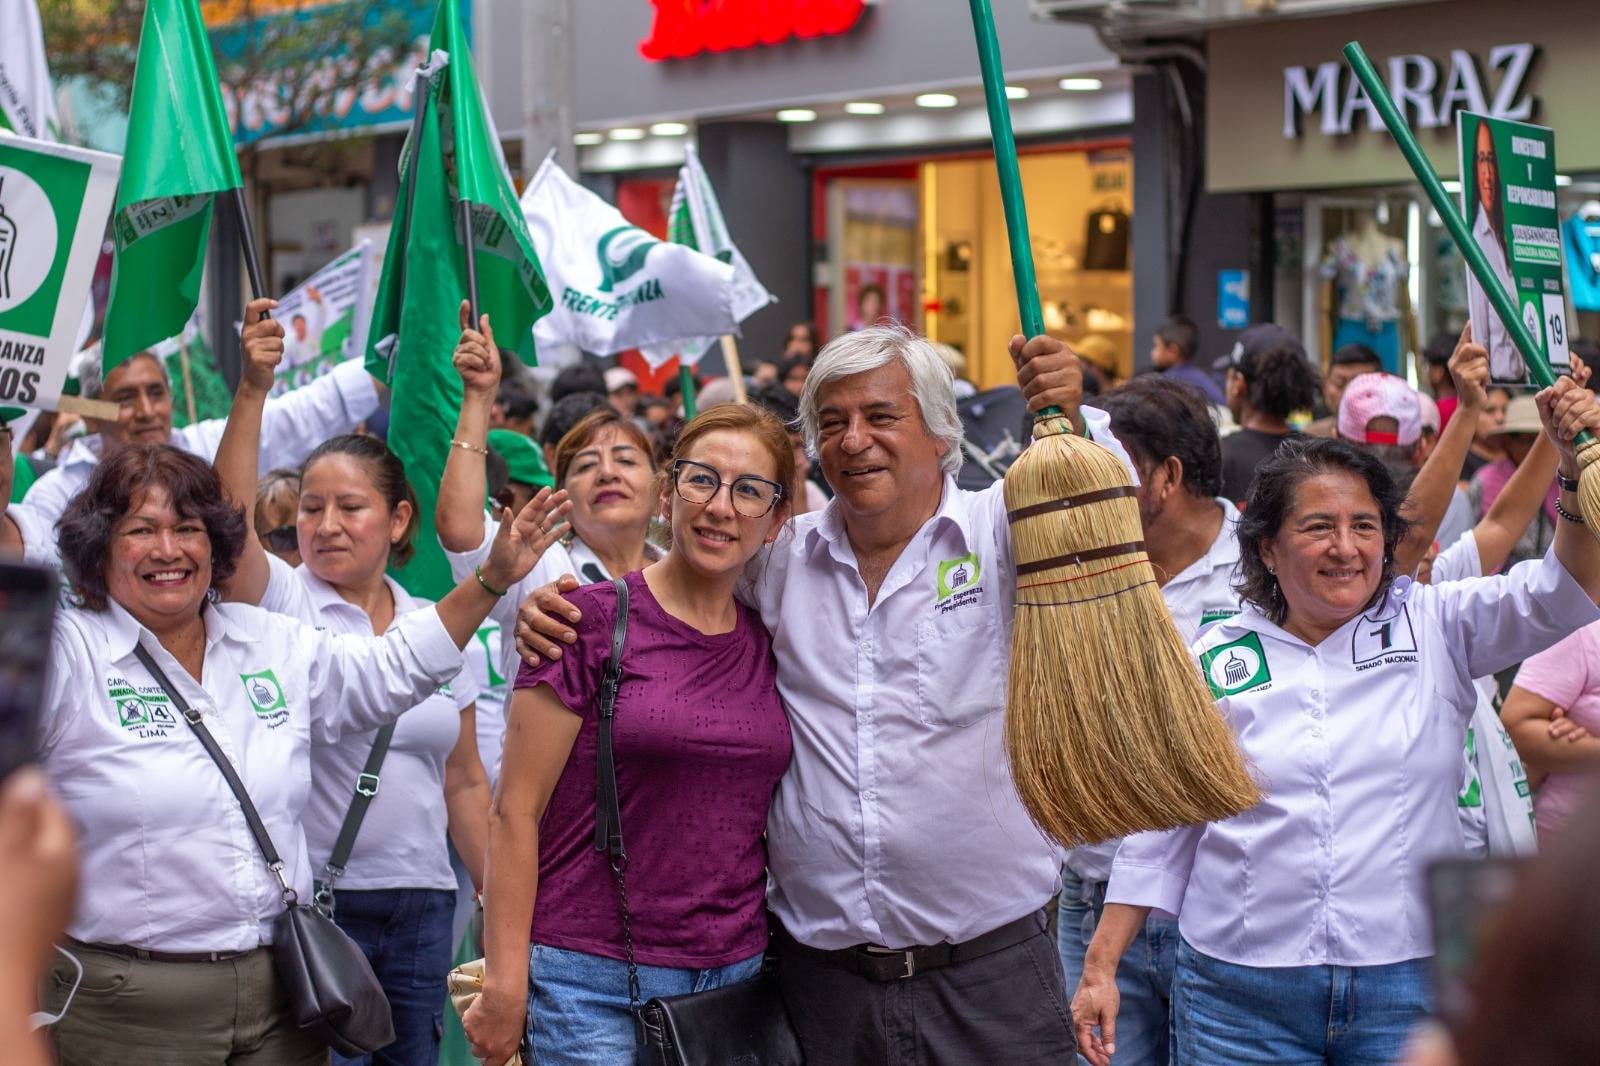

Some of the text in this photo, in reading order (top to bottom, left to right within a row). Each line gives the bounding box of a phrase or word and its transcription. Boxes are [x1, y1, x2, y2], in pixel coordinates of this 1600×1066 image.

[1283, 43, 1533, 138] MARAZ
[1549, 314, 1563, 345] 19
[0, 338, 45, 366] ANZA
[0, 366, 41, 404] OS
[953, 587, 983, 600] Esperanza
[941, 597, 977, 614] Presidente
[1369, 621, 1392, 650] 1
[1355, 655, 1419, 672] SENADO NACIONAL
[154, 706, 168, 720] 4
[139, 728, 168, 738] LIMA
